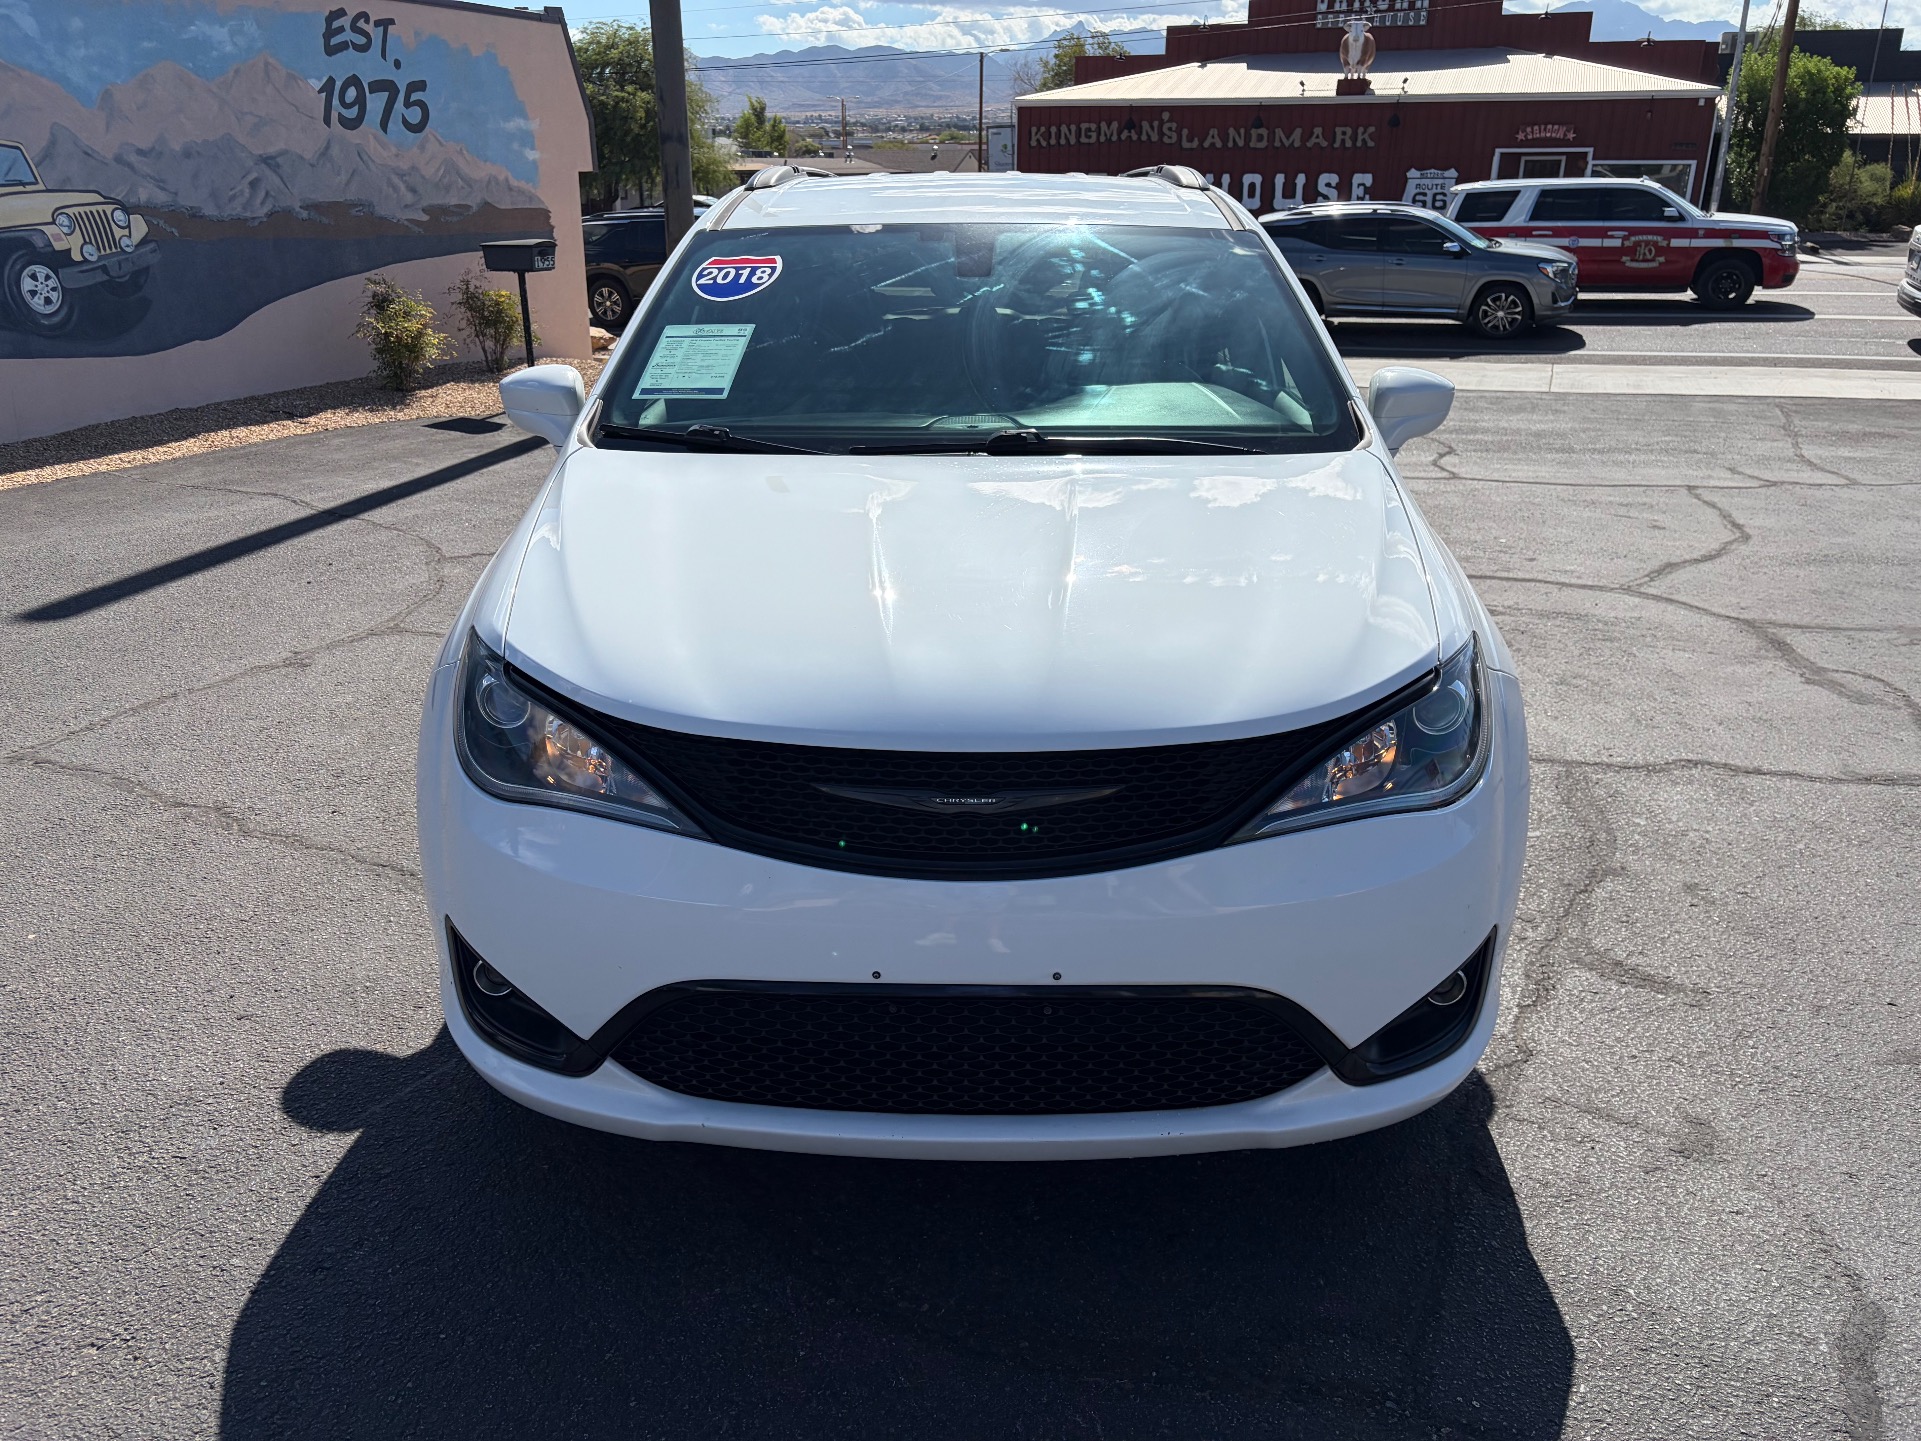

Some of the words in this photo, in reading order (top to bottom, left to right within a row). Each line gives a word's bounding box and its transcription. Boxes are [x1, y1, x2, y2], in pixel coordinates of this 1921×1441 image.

[322, 7, 402, 70] EST.
[317, 74, 430, 135] 1975
[1030, 111, 1178, 147] KINGMAN'S
[1181, 127, 1376, 149] LANDMARK
[1526, 124, 1567, 139] SALOON
[1415, 182, 1447, 191] ROUTE
[1412, 191, 1448, 210] 66
[536, 256, 555, 268] 1955
[696, 267, 772, 285] 2018
